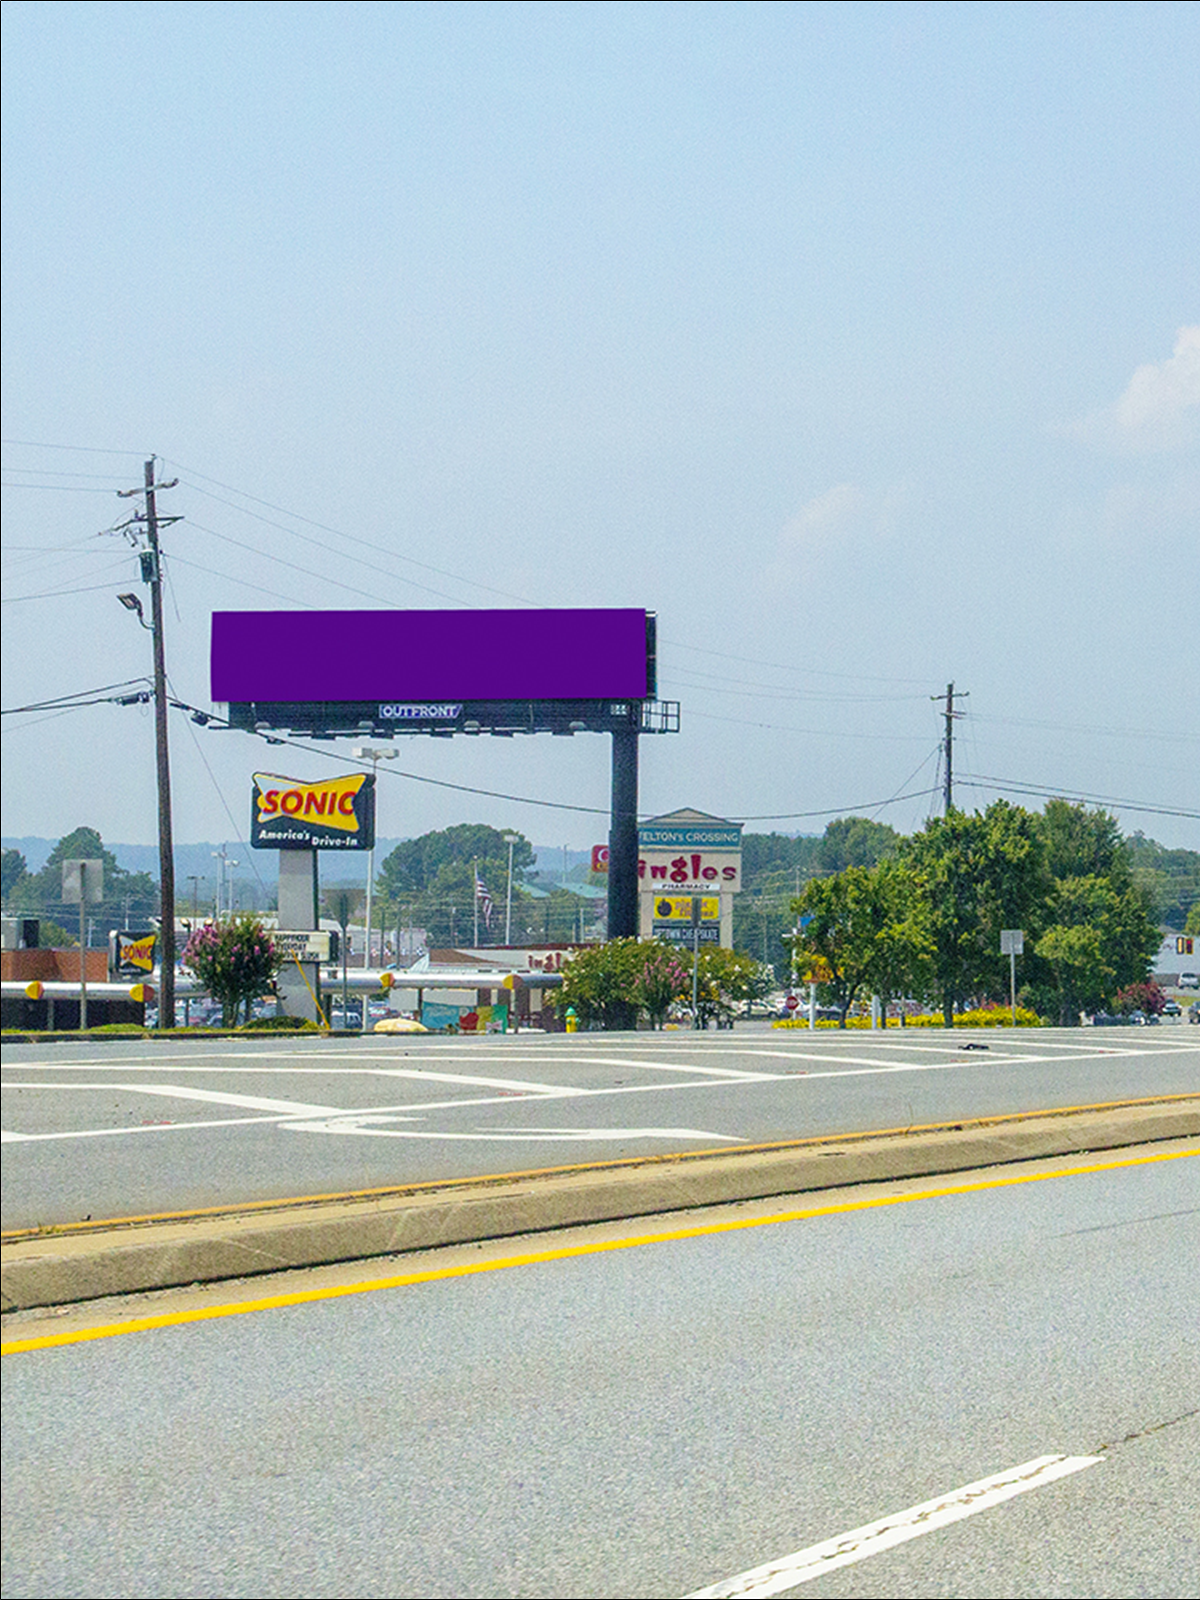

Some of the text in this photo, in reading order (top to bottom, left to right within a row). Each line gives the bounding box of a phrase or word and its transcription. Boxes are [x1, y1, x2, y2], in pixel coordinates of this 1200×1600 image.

[382, 705, 456, 717] OUTFRONT
[262, 789, 357, 815] SONIC
[259, 829, 358, 845] America's Drive-In
[685, 832, 738, 842] CROSSING
[638, 854, 737, 883] ingles
[121, 945, 153, 960] SONIC
